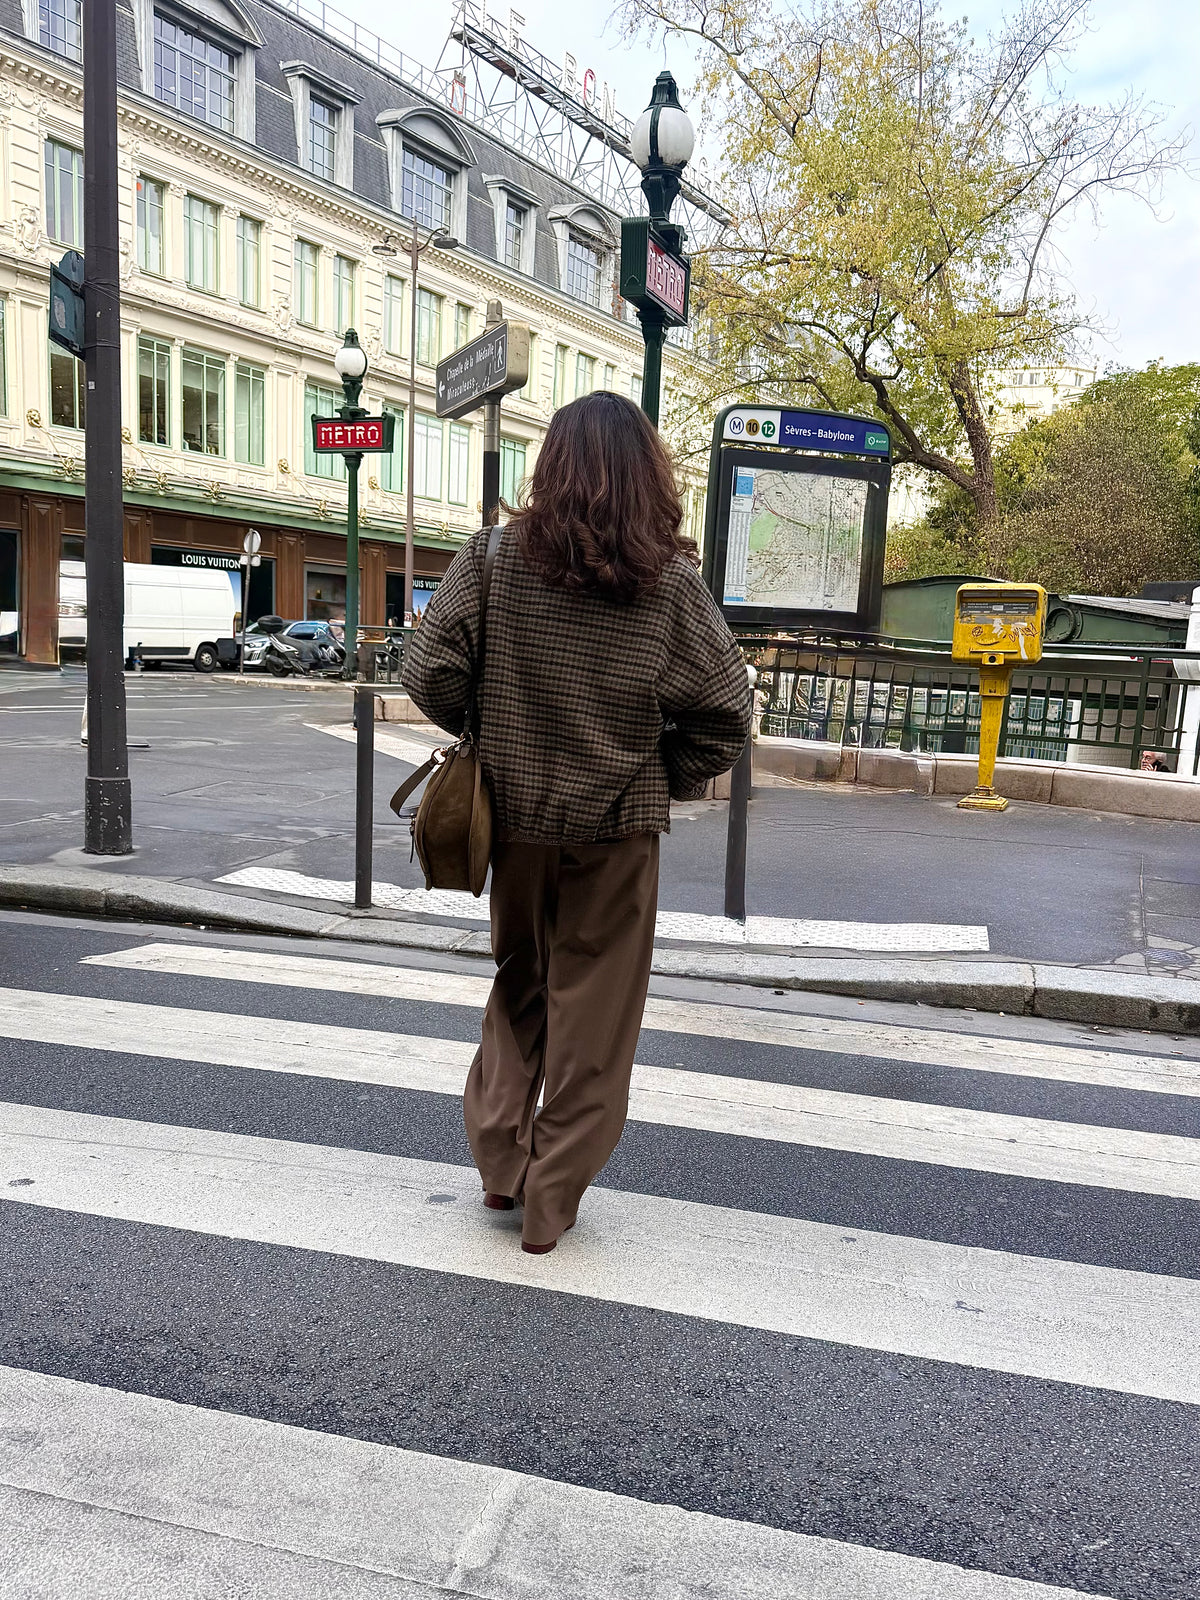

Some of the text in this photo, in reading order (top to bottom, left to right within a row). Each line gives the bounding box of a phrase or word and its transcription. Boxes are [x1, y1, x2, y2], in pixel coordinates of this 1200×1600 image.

[563, 51, 617, 128] BON
[648, 246, 685, 306] METRO
[446, 343, 495, 381] Chapelle de la Médaille
[321, 425, 380, 445] METRO
[747, 422, 758, 433] 10
[763, 424, 774, 435] 12
[181, 553, 241, 569] LOUIS VUITTON
